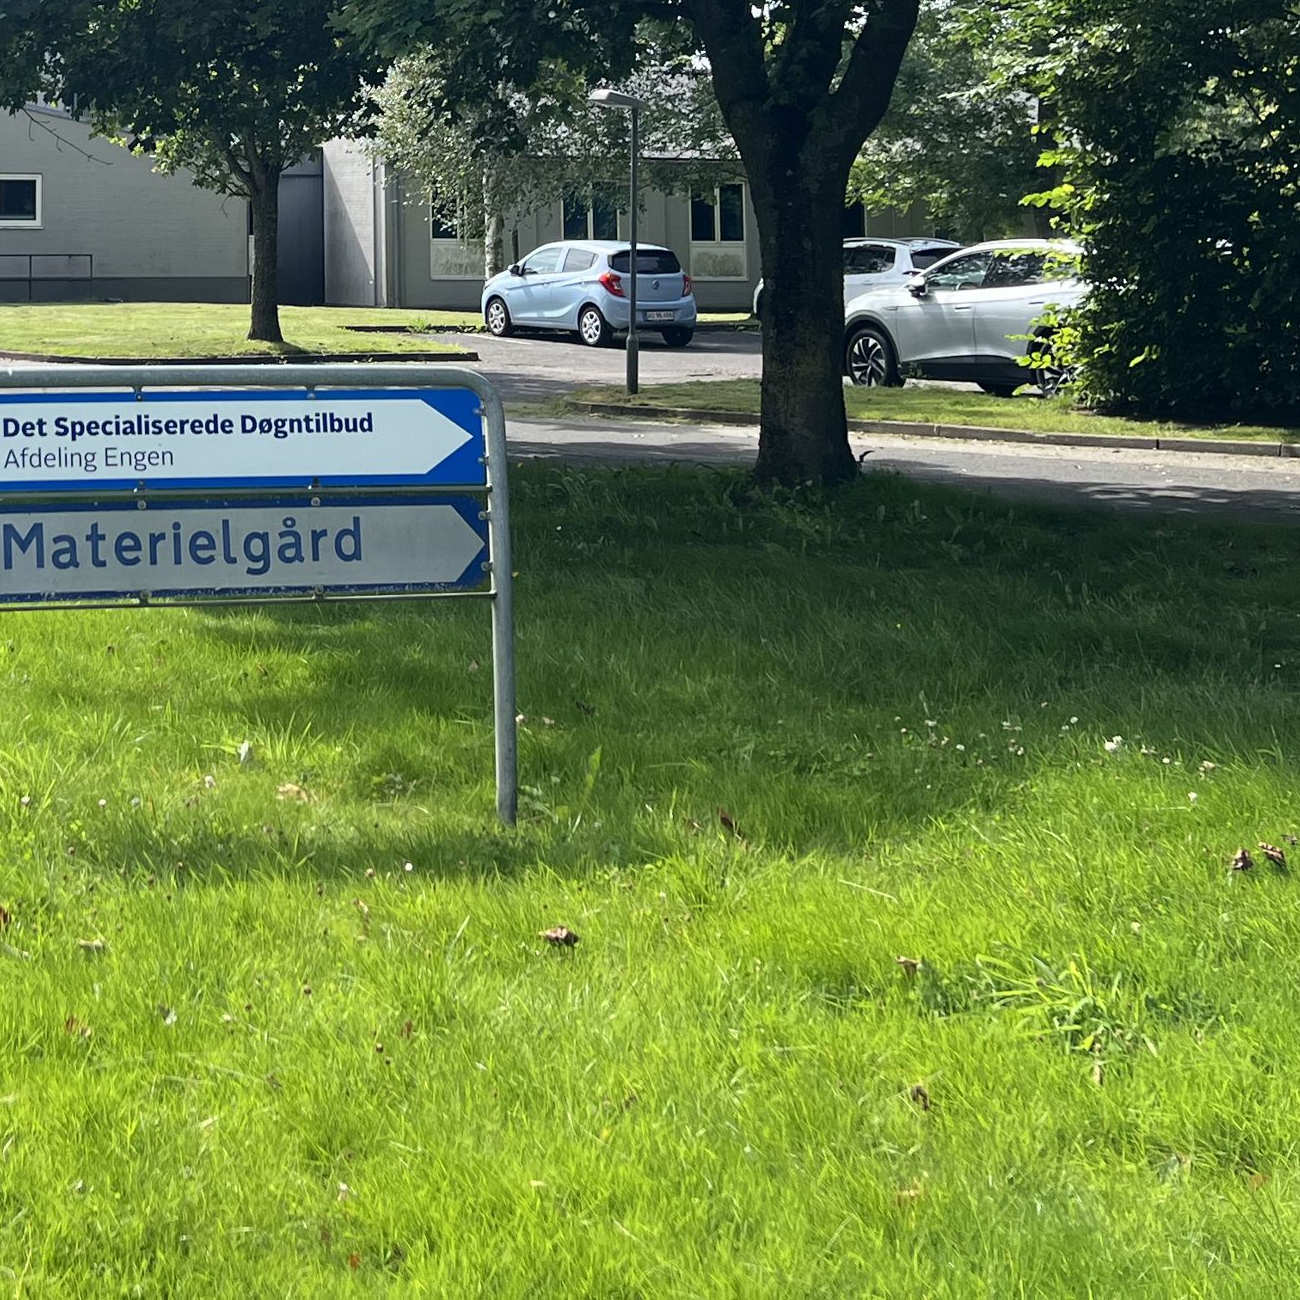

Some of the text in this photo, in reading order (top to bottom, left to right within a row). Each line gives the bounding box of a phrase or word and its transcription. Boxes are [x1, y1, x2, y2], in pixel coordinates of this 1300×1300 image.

[2, 412, 374, 442] Det Specialiserede Døgntilbud
[3, 447, 174, 473] Afdeling Engen
[2, 515, 364, 577] Materielgård
